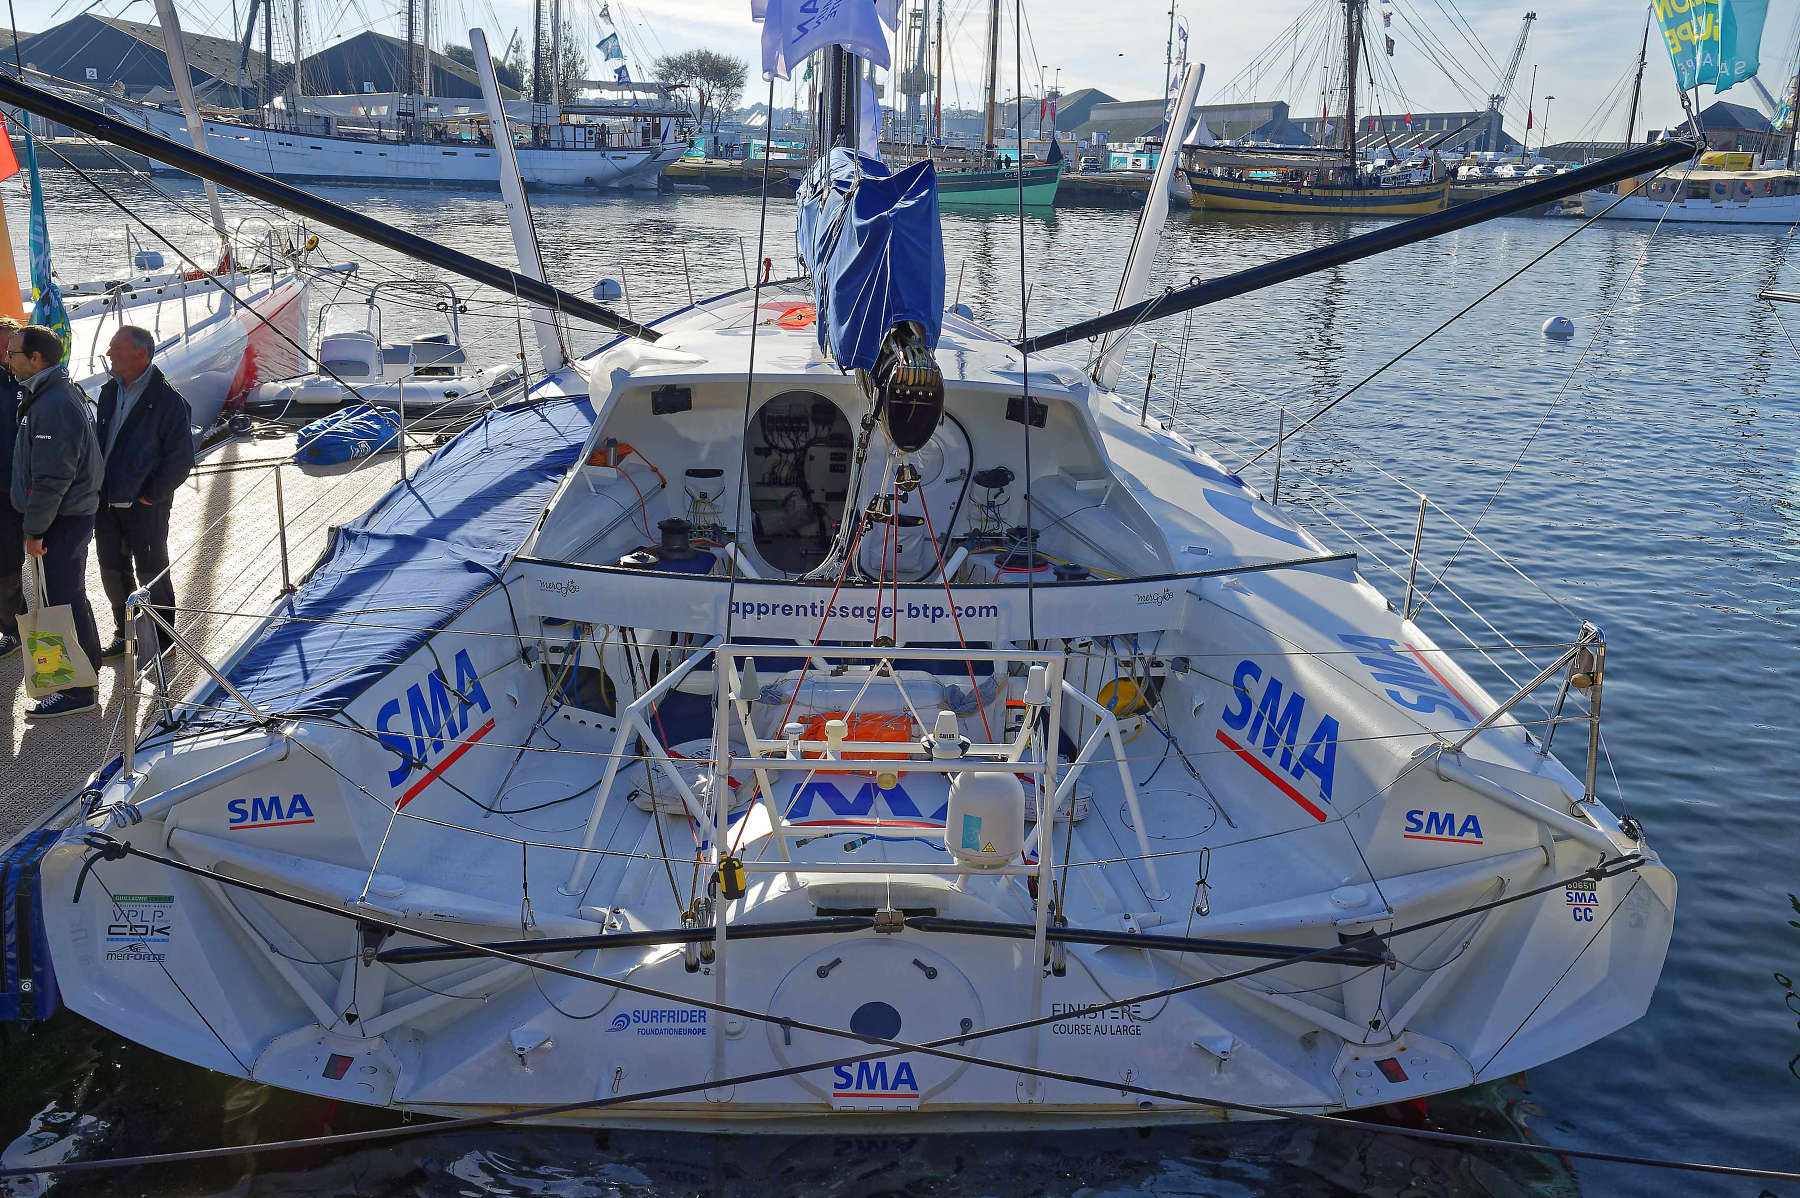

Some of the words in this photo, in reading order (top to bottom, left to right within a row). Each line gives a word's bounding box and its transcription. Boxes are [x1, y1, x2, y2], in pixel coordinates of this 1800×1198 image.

[731, 600, 999, 623] apprentissage-btp.com
[377, 648, 492, 788] SMA
[1222, 660, 1340, 804] SMA
[227, 794, 314, 823] SMA
[1404, 809, 1483, 838] SMA
[1566, 891, 1598, 903] SMA
[112, 909, 164, 922] VPLP
[1573, 907, 1593, 922] CC
[108, 925, 171, 936] CDK
[632, 1009, 707, 1024] SURFRIDER
[1052, 1024, 1091, 1035] COURSE
[1094, 1024, 1108, 1036] AU
[1110, 1025, 1141, 1036] LARGE
[833, 1061, 919, 1091] SMA
